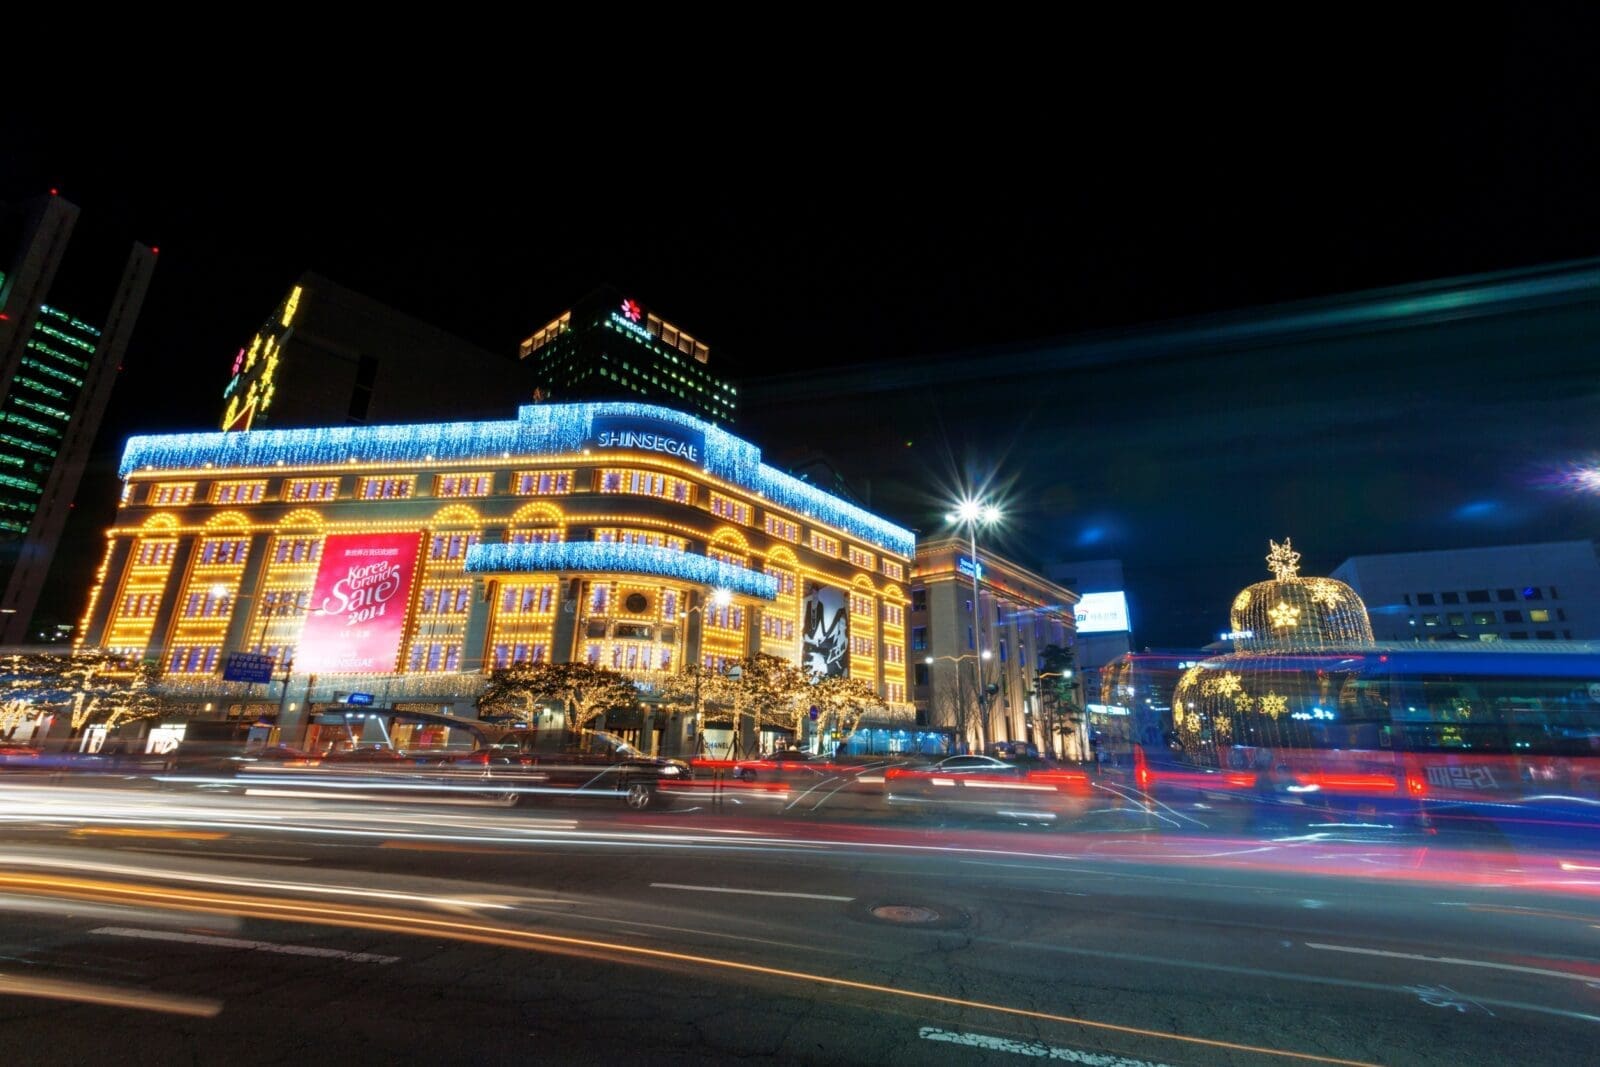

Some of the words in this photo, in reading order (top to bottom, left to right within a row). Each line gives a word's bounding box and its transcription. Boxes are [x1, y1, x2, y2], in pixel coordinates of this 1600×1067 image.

[597, 431, 698, 462] SHINSEGAE
[347, 560, 388, 580] Korea
[351, 565, 397, 590] Grand
[323, 572, 400, 615] Sale
[347, 602, 386, 625] 2014
